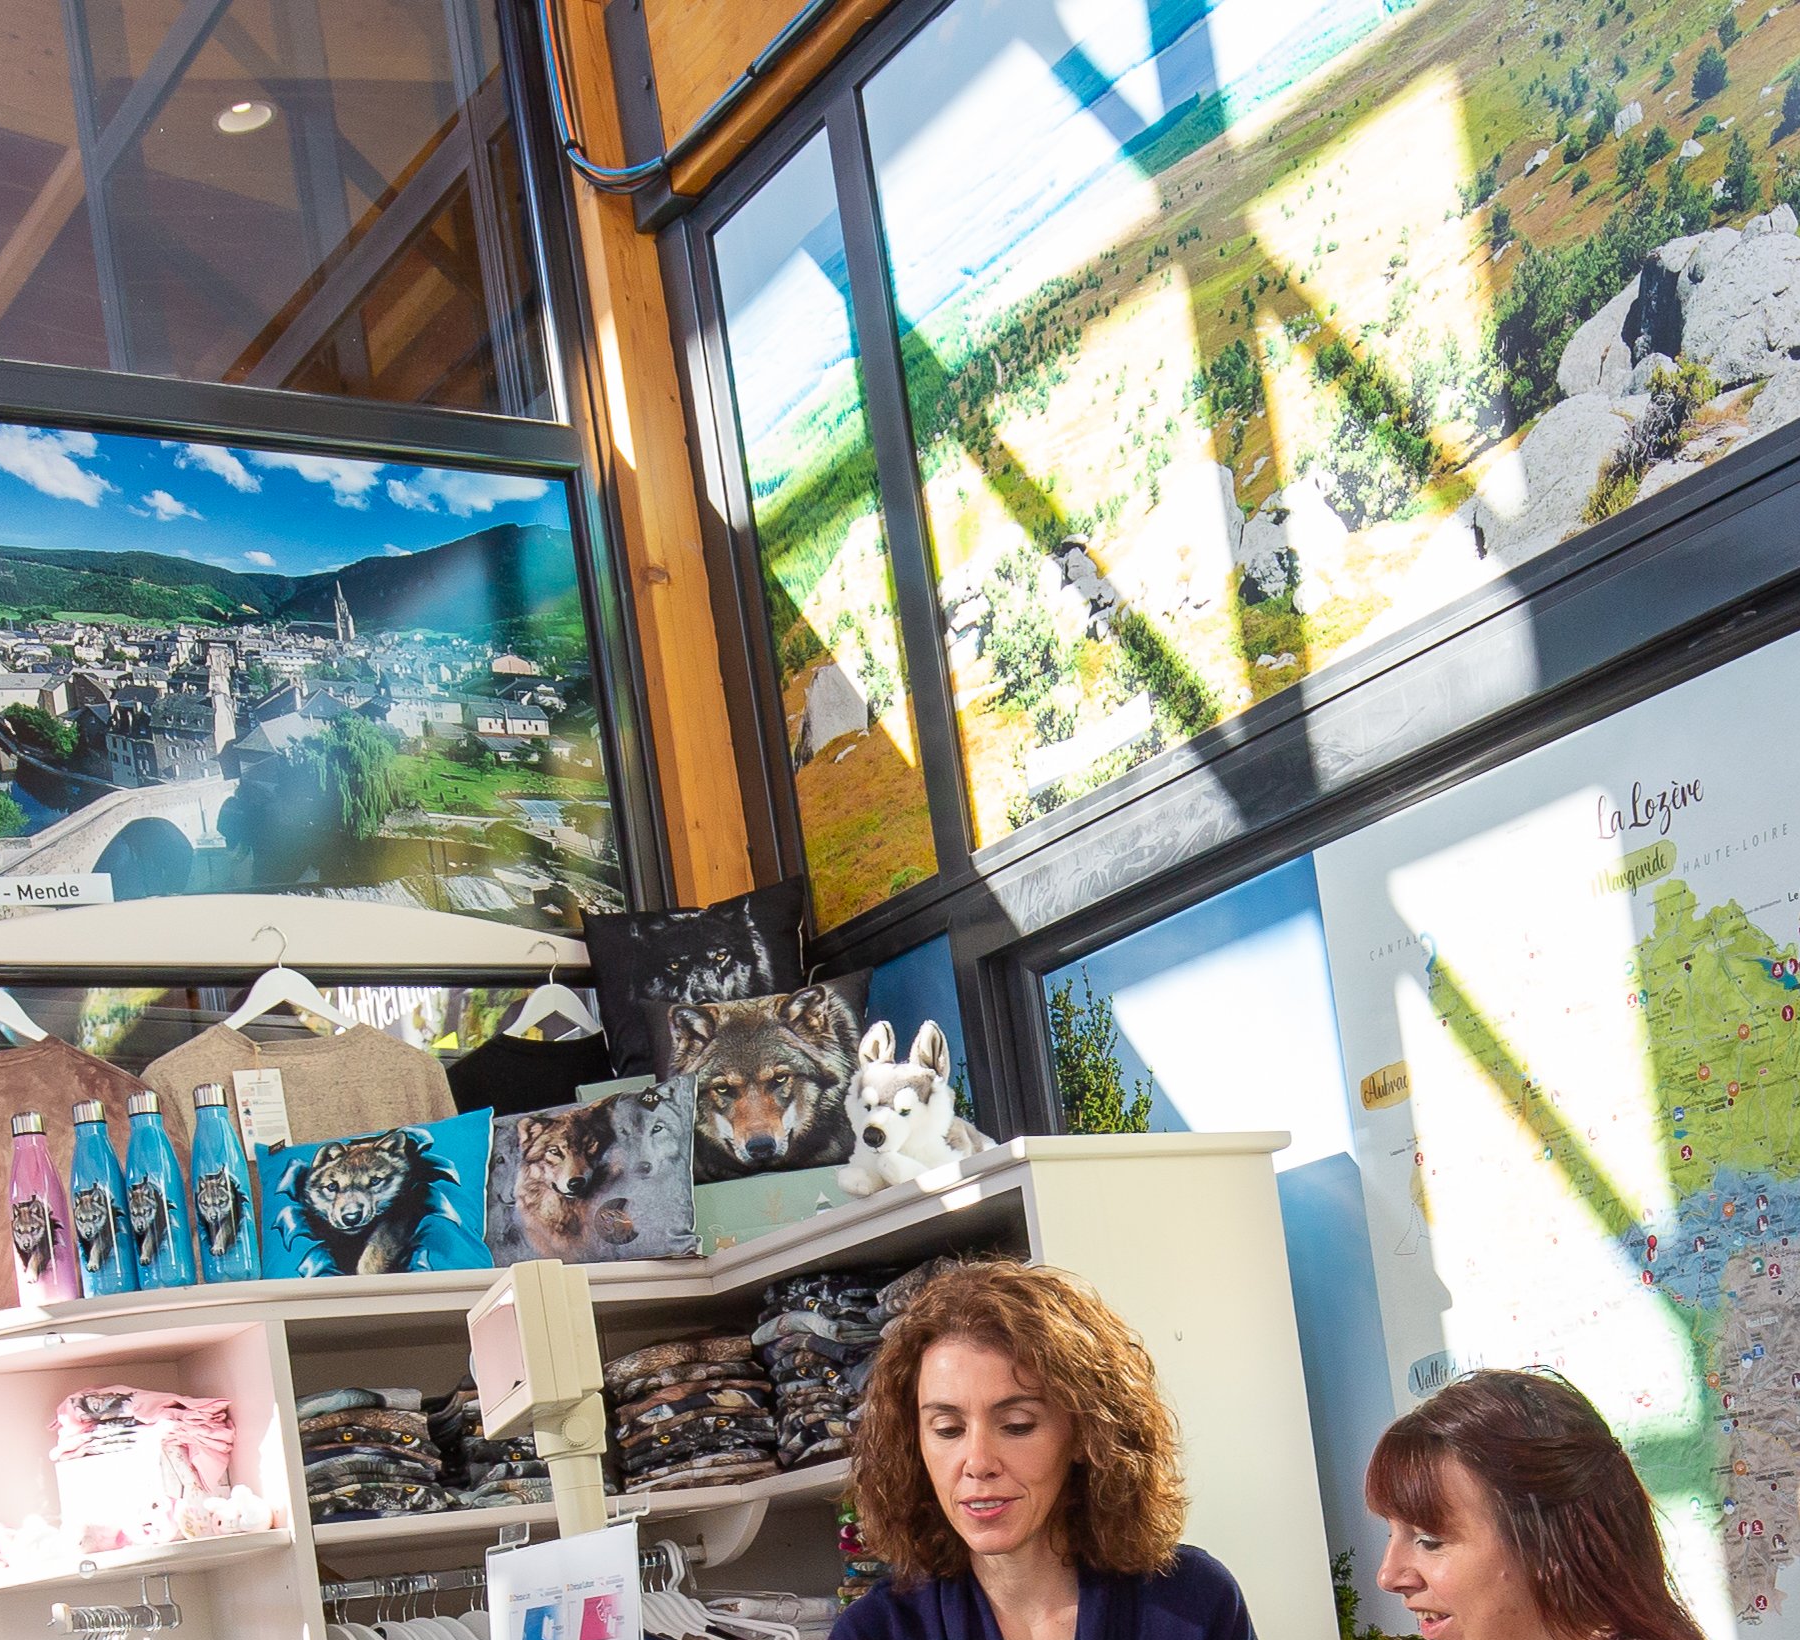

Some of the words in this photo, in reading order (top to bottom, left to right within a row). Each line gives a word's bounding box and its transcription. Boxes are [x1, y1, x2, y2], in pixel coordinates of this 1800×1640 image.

[1597, 795, 1625, 839] La
[1629, 779, 1704, 835] Lozère
[1683, 823, 1789, 874] HAUTE-LOIRE
[17, 882, 80, 901] Mende
[1787, 892, 1799, 902] Le
[1369, 935, 1419, 961] CANTAL
[1363, 1071, 1409, 1104] Aubrac
